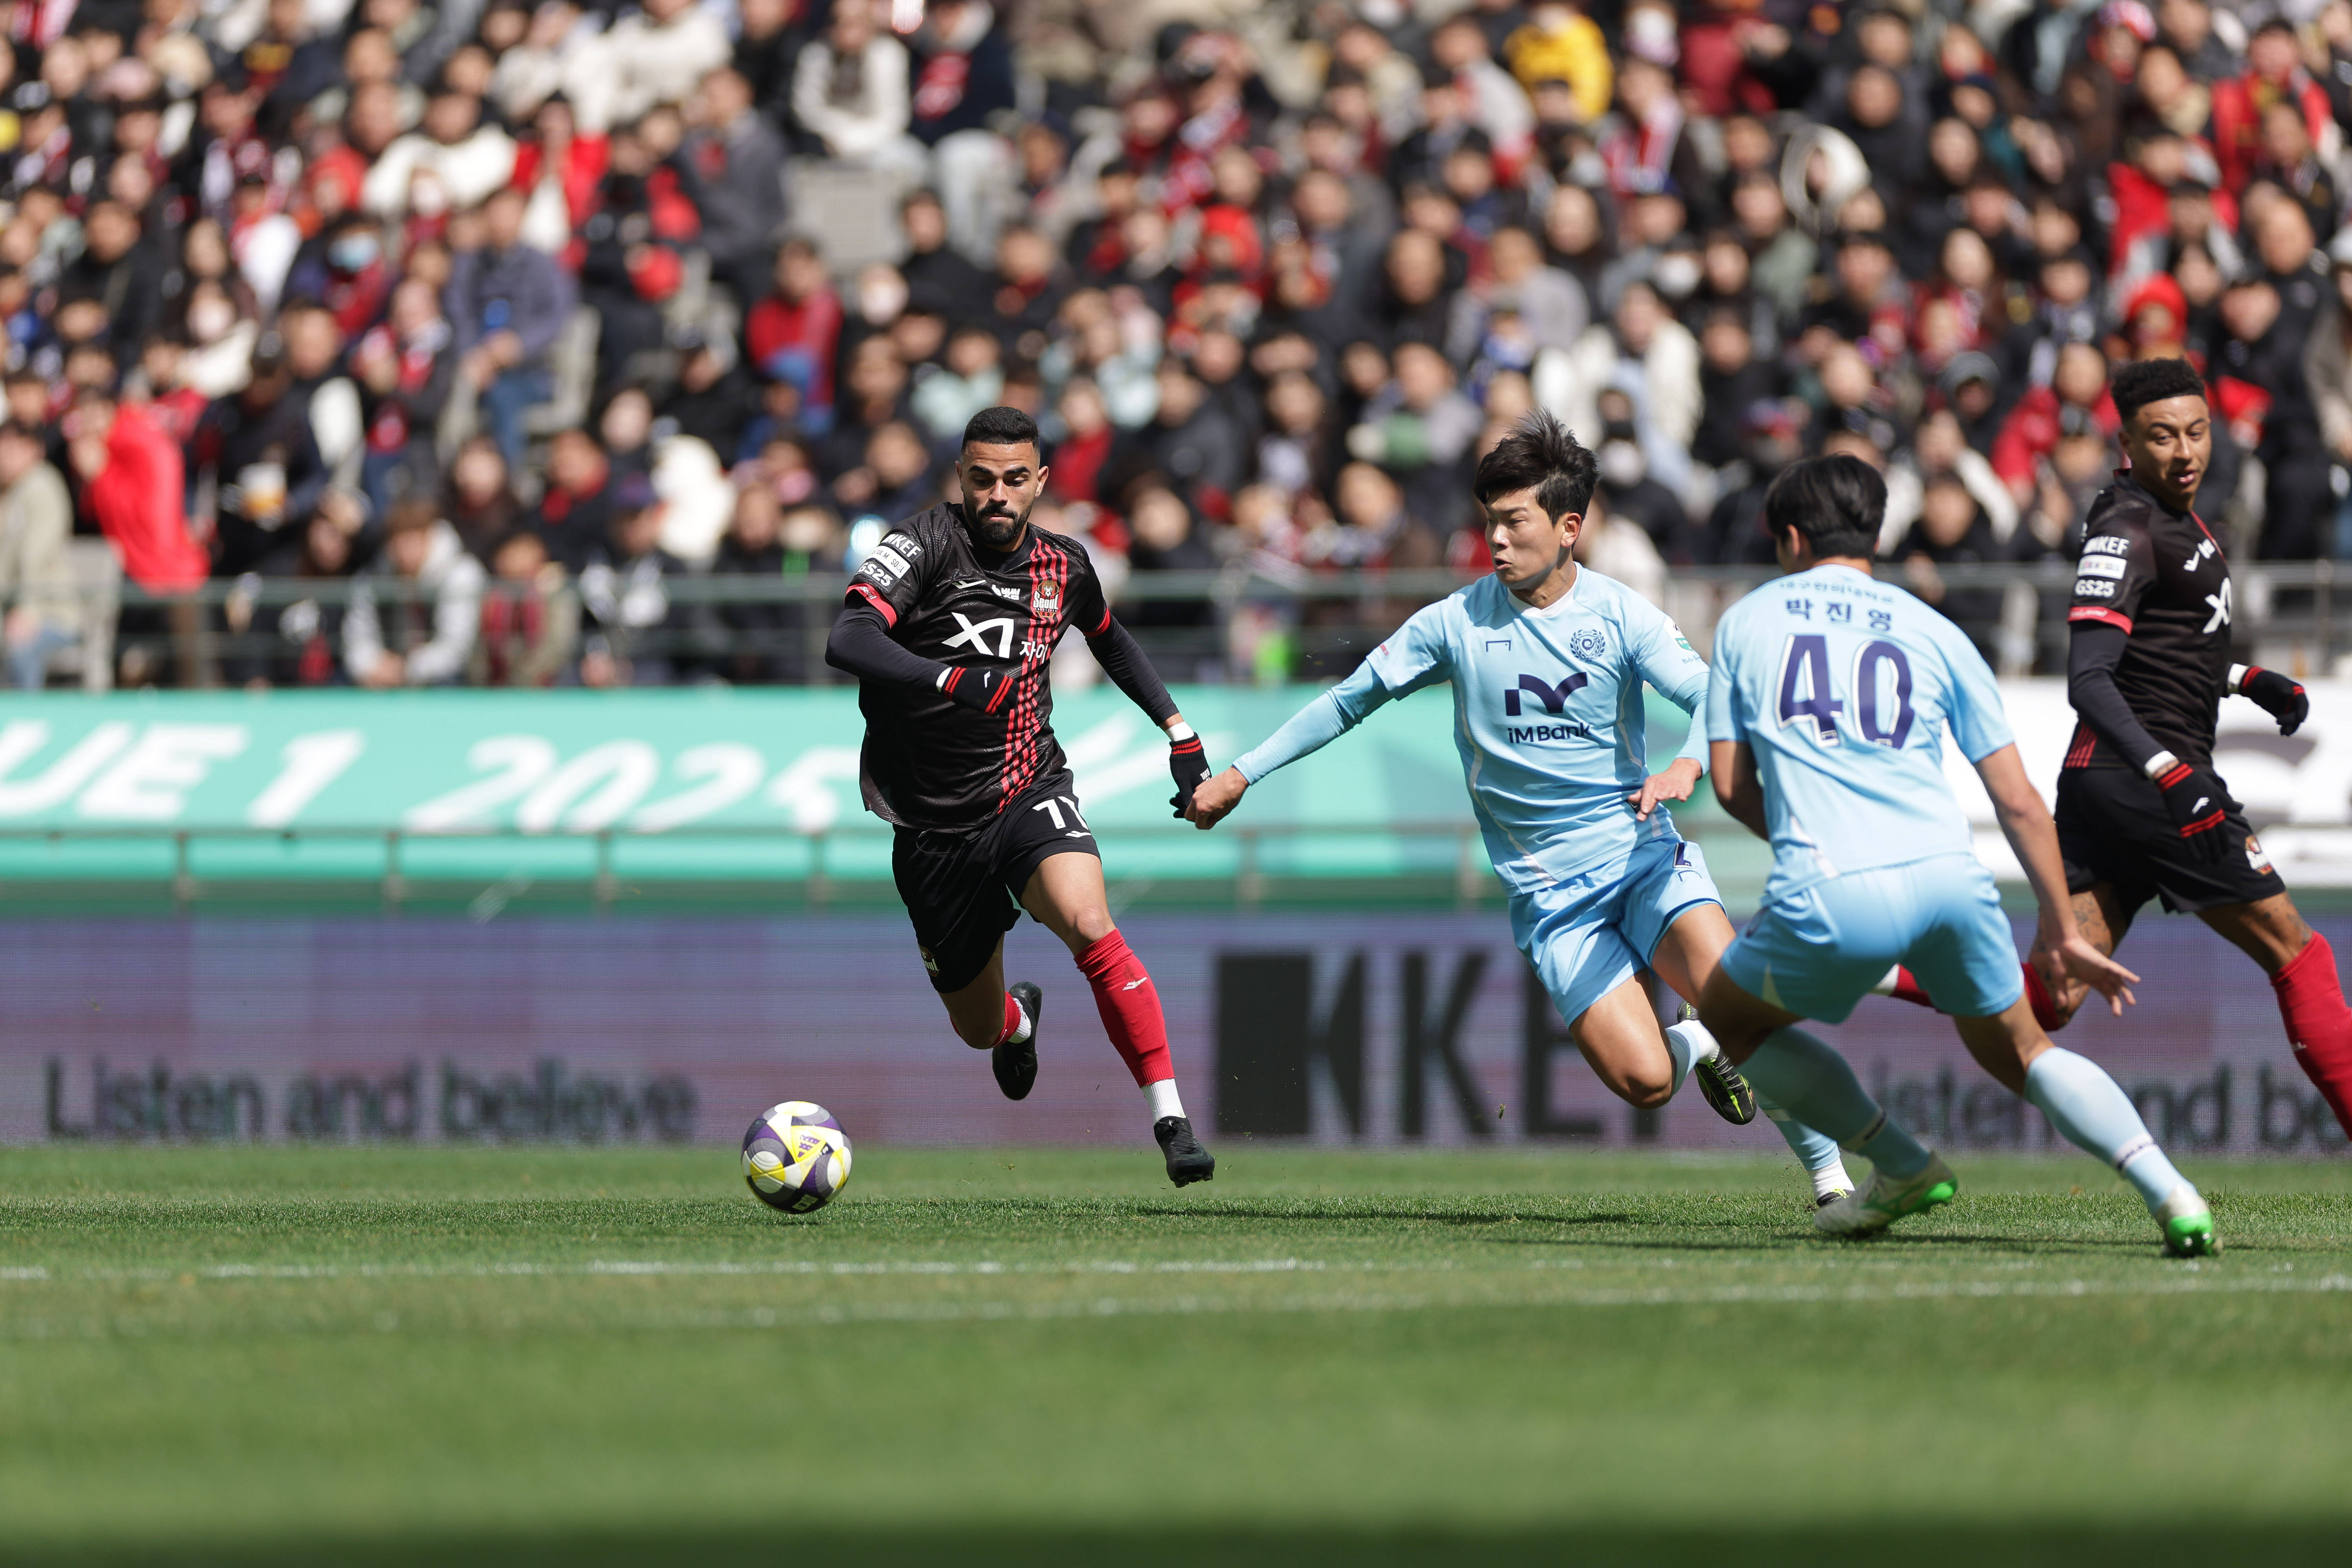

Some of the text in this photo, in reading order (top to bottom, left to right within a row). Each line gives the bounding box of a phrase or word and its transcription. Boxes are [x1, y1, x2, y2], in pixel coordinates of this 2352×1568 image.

[856, 562, 893, 586] GS25
[1033, 590, 1059, 610] Seoul
[2075, 579, 2116, 598] GS25
[1019, 641, 1049, 664] 자이
[1774, 633, 1915, 750] 40
[246, 728, 367, 831] 1
[46, 1055, 700, 1140] Listen and believe
